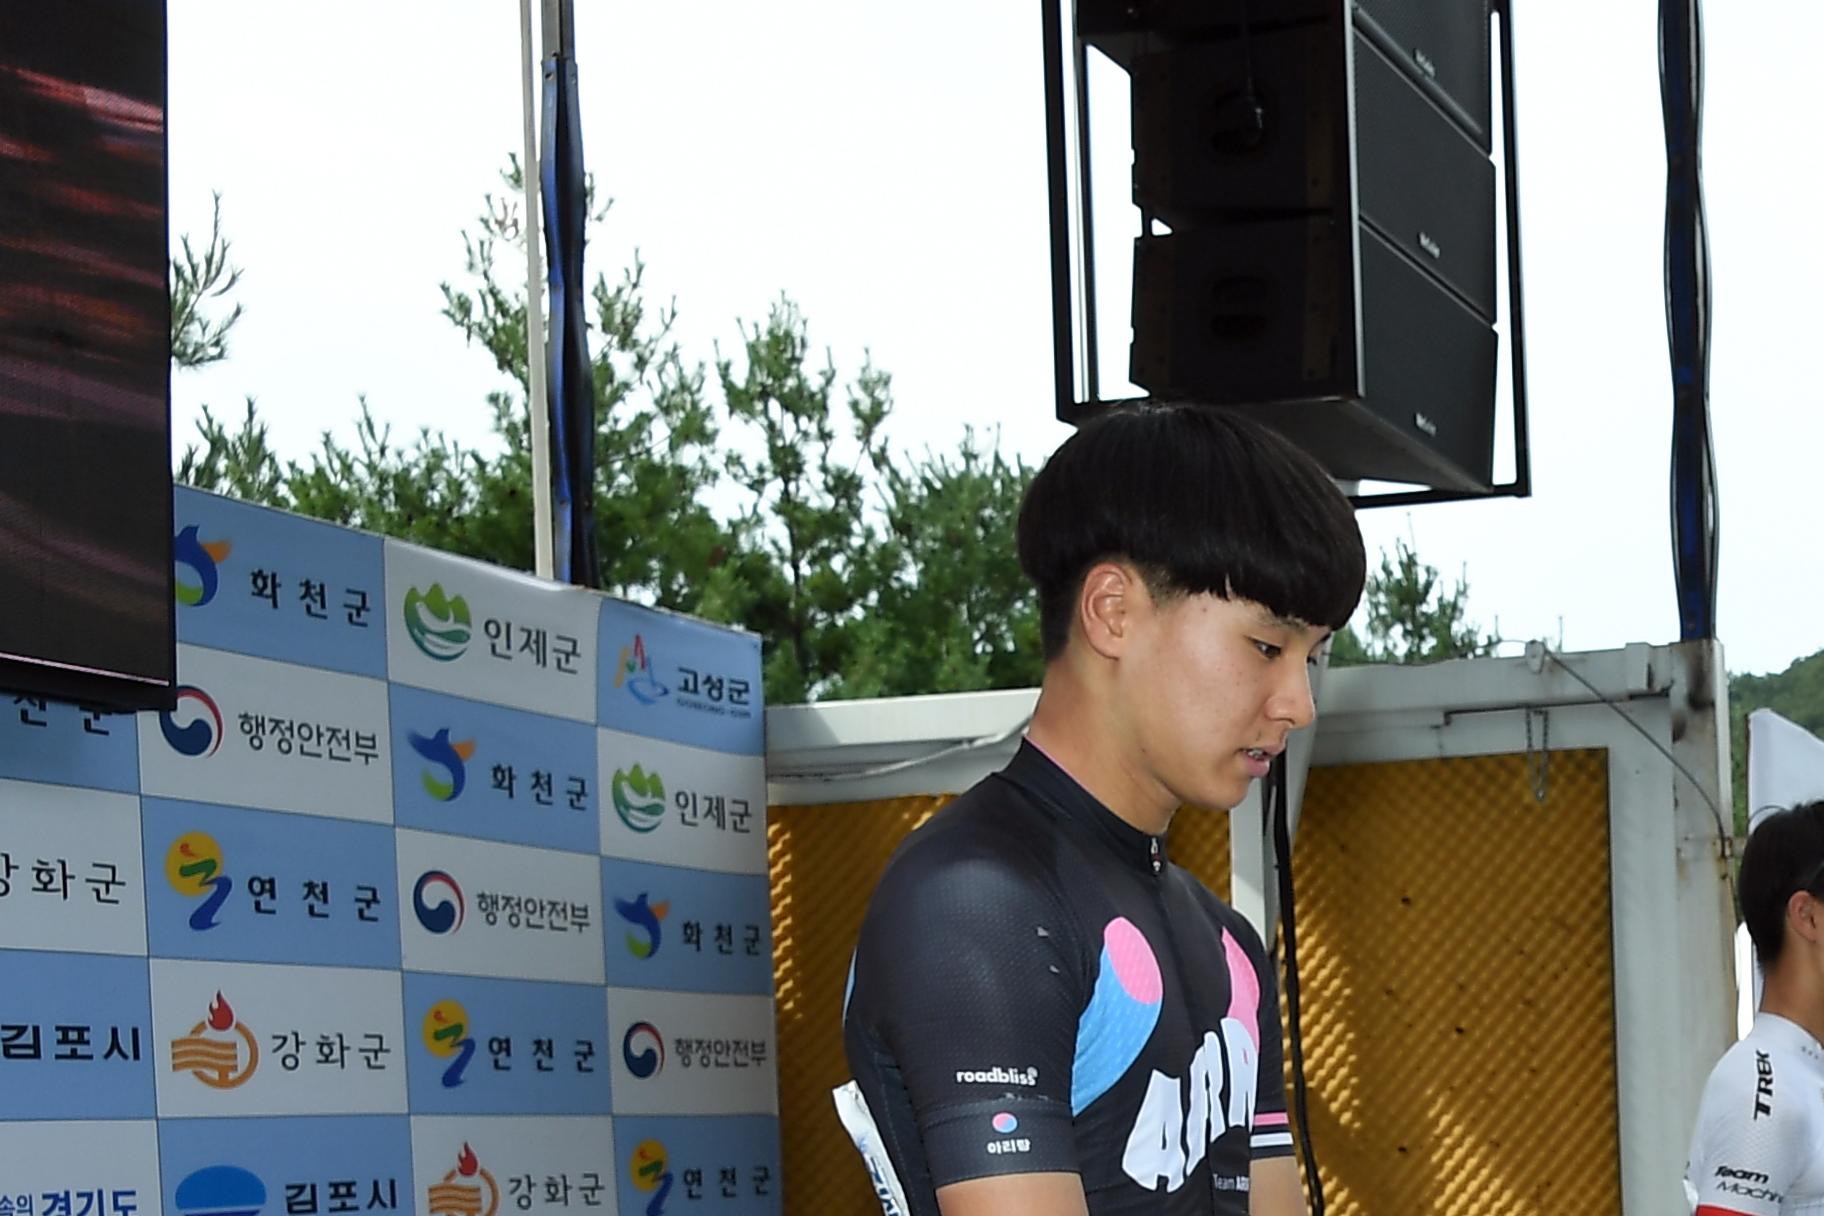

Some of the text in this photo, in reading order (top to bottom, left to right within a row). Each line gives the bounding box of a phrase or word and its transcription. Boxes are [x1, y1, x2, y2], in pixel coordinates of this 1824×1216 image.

[251, 568, 371, 628] 화천군
[484, 617, 582, 674] 인제군
[678, 667, 750, 706] 고성군
[238, 711, 379, 766] 행정안전부
[490, 763, 588, 811] 화천군
[675, 789, 753, 833] 인제군
[247, 875, 381, 922] 연천군
[476, 891, 591, 934] 행정안전부
[681, 920, 762, 955] 화천군
[0, 1024, 141, 1062] 김포시
[272, 1031, 392, 1071] 강화군
[488, 1036, 595, 1073] 연천군
[674, 1037, 767, 1068] 행정안전부
[956, 1066, 1038, 1086] roadbliss
[508, 1173, 606, 1212] 강화군
[683, 1166, 772, 1198] 연천군
[1714, 1165, 1769, 1185] Team
[285, 1179, 398, 1215] 김포시
